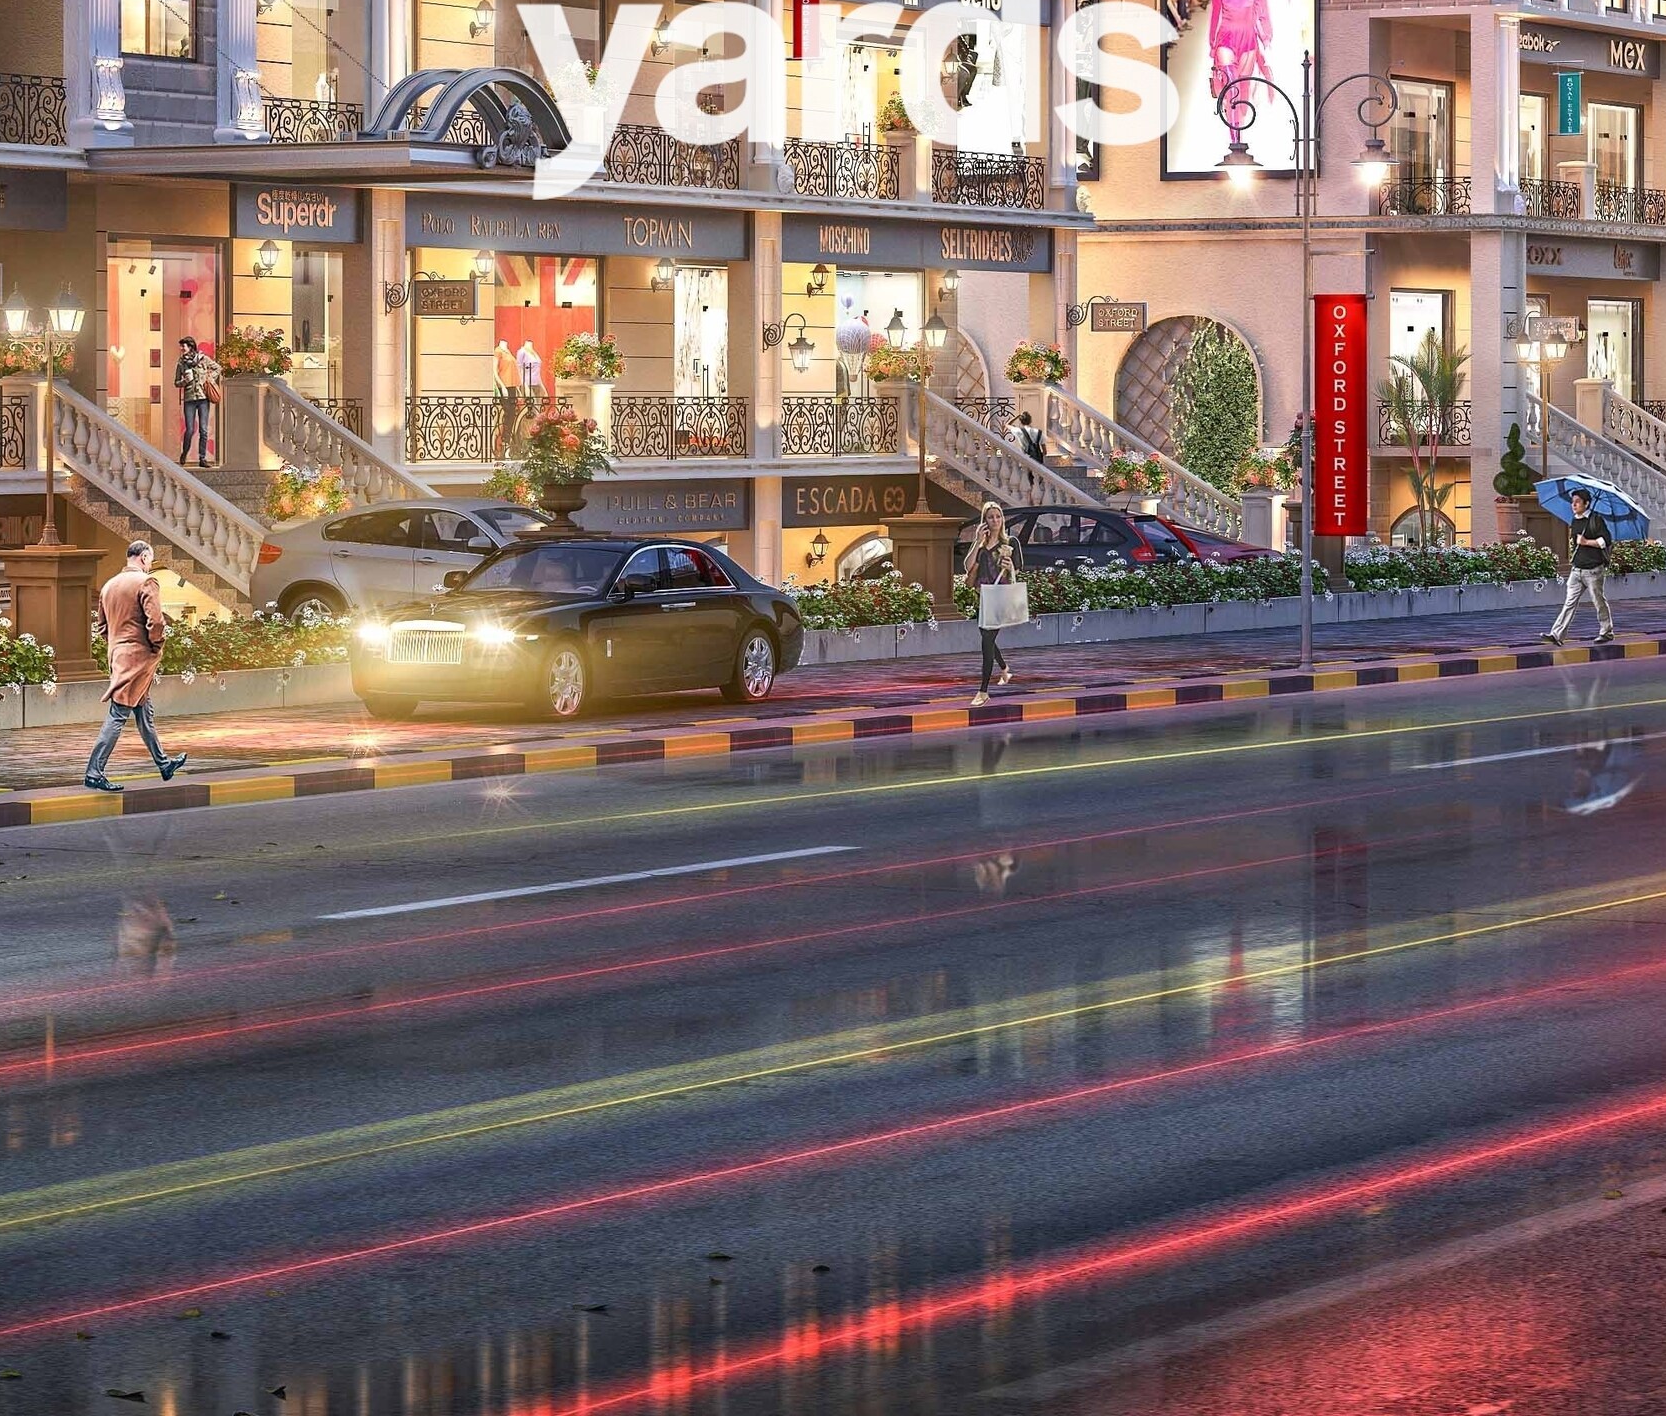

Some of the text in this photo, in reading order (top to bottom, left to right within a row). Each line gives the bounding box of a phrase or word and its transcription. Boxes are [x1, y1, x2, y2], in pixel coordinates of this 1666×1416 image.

[256, 191, 336, 234] Superdr
[422, 211, 455, 235] POLO
[469, 215, 512, 239] RALPH
[819, 225, 871, 255] MOSCHINO
[422, 287, 468, 298] OXFORD
[422, 299, 464, 310] STREET
[1098, 308, 1138, 317] OXFORD
[1098, 318, 1135, 327] STREET
[1333, 305, 1346, 527] OXFORD STREET
[607, 492, 737, 512] PULL & BEAR
[796, 486, 878, 516] ESCADA
